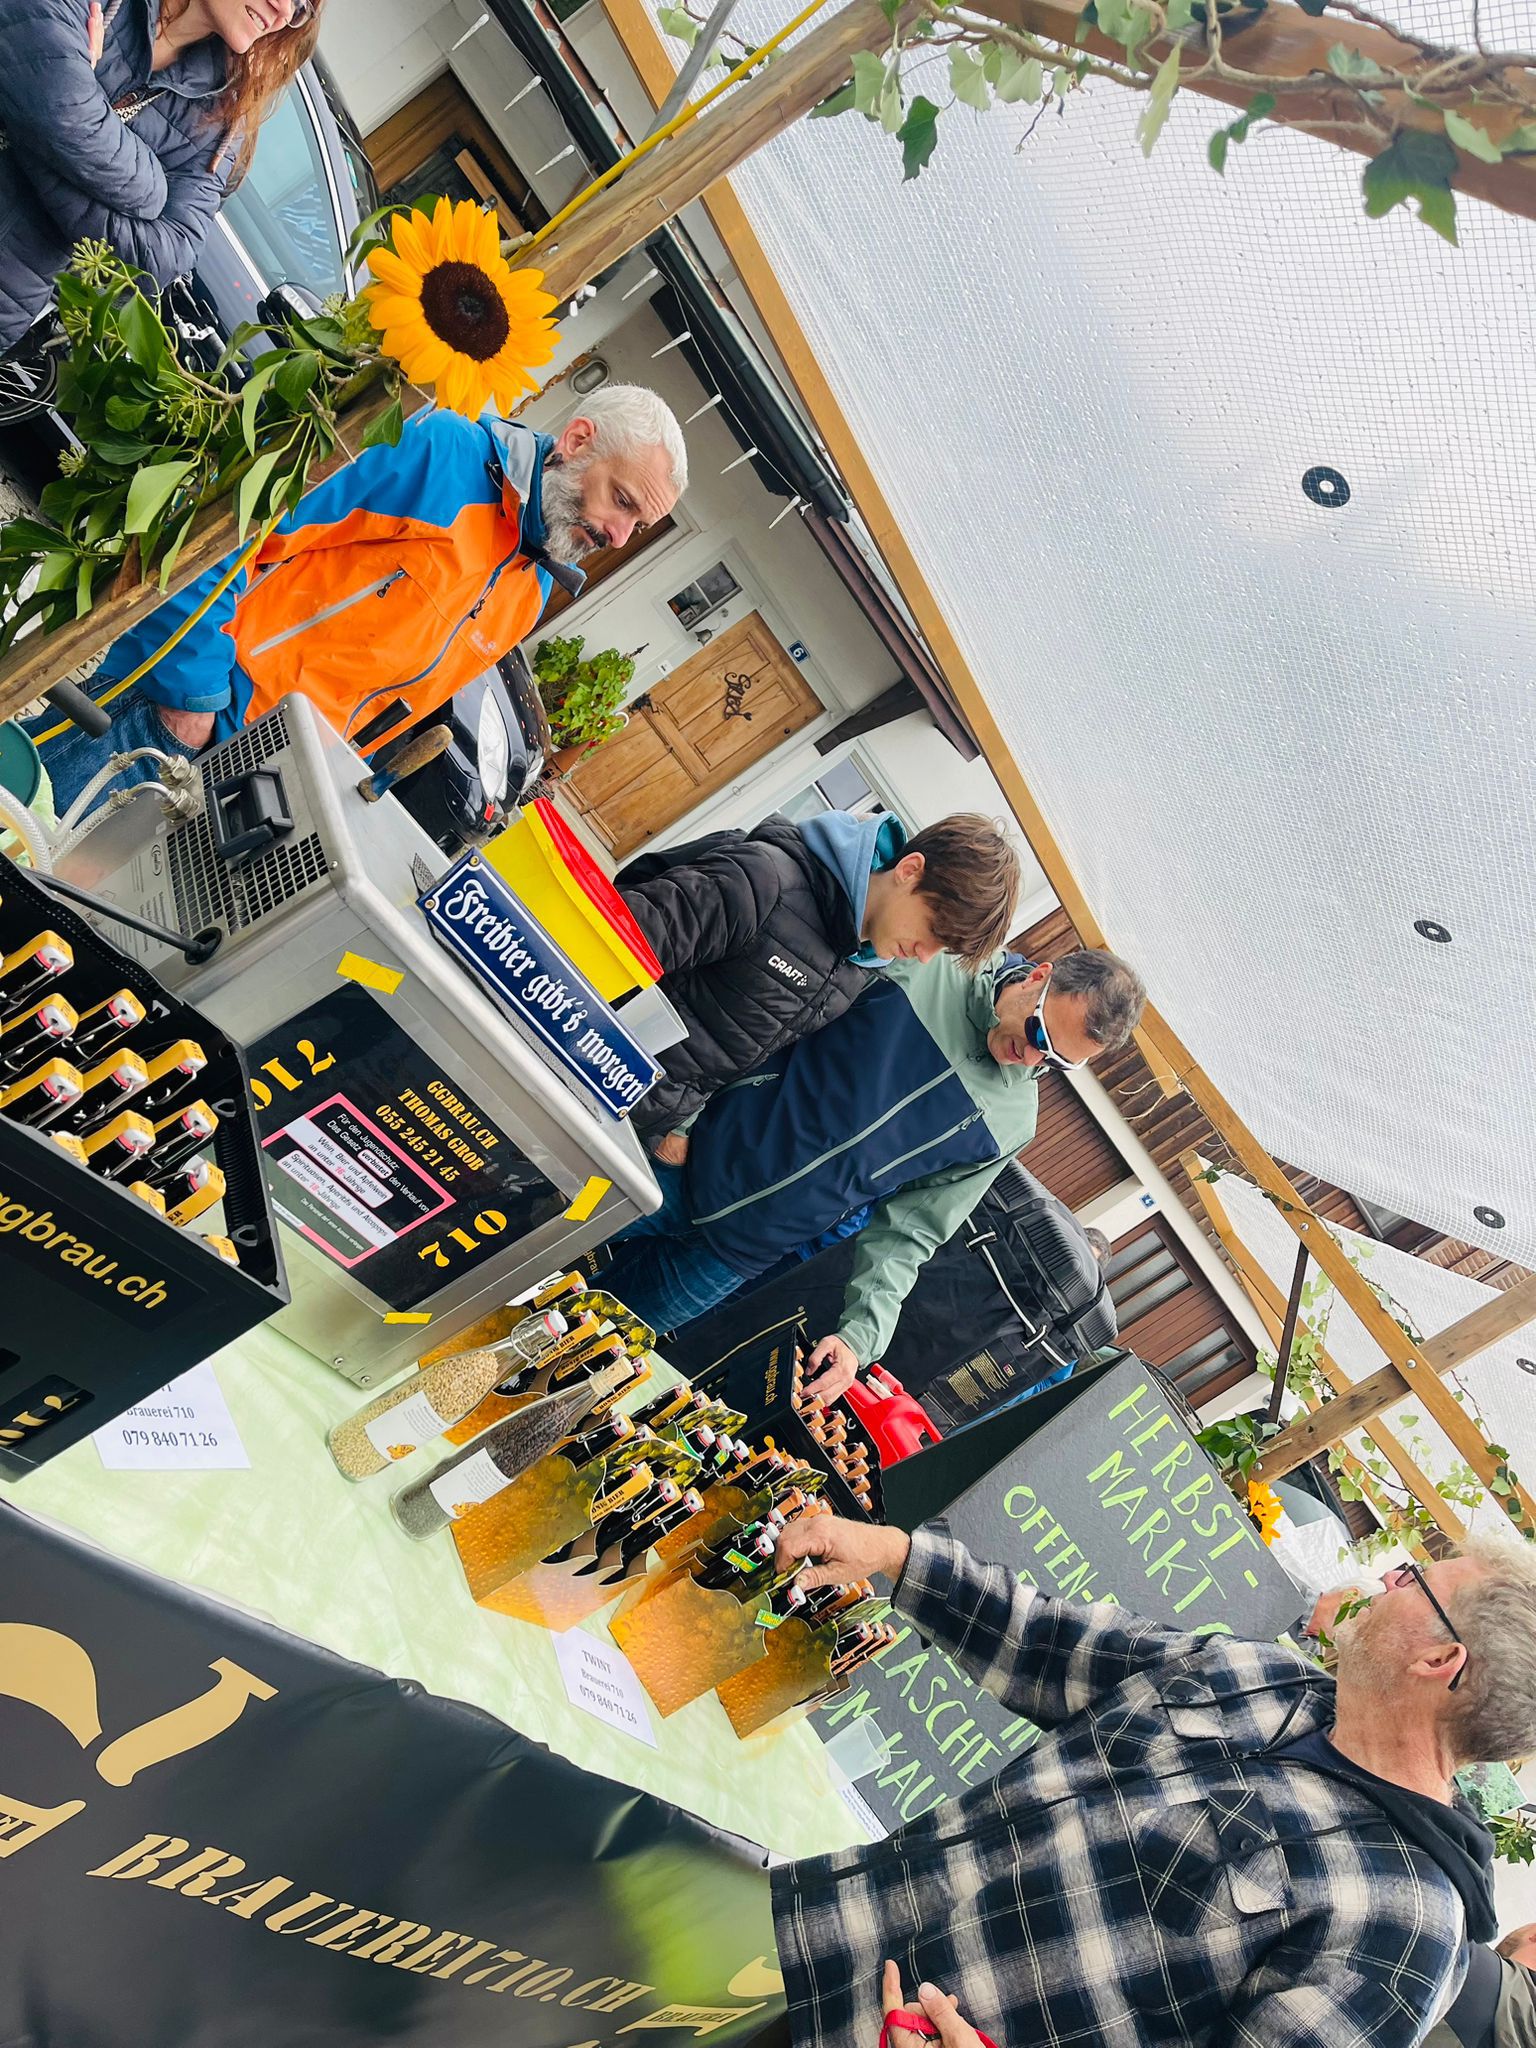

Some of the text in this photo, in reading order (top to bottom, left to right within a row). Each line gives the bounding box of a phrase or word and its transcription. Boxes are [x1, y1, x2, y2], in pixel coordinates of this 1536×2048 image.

[792, 647, 804, 658] 6
[768, 954, 804, 982] CRAFT
[445, 879, 536, 978] Freibier
[577, 1028, 645, 1102] morgen
[337, 1113, 351, 1125] Für
[350, 1124, 361, 1136] den
[397, 1087, 485, 1172] THOMAS GROB
[426, 1080, 500, 1150] GGBRAU.CH
[307, 1143, 318, 1153] an
[316, 1151, 335, 1167] unter
[375, 1104, 461, 1182] 055 245 21 45
[281, 1160, 292, 1170] an
[290, 1167, 309, 1183] unter
[327, 1120, 430, 1213] Das Gesetz verbietet den Verkauf von
[335, 1152, 350, 1166] Bier
[349, 1163, 362, 1176] und
[360, 1174, 388, 1200] Apfelwein
[351, 1203, 363, 1217] und
[363, 1214, 388, 1237] Alcopops
[417, 1209, 507, 1268] 710
[173, 1406, 195, 1419] 710
[122, 1429, 218, 1447] 079 840 71 26
[607, 1489, 625, 1503] BIER
[1086, 1450, 1227, 1614] MARKT
[581, 1649, 612, 1675] TWINT
[580, 1668, 625, 1699] Brauerei 710
[579, 1684, 638, 1725] 079 840 71 26
[86, 1834, 656, 2013] BRAUEREI710.CH
